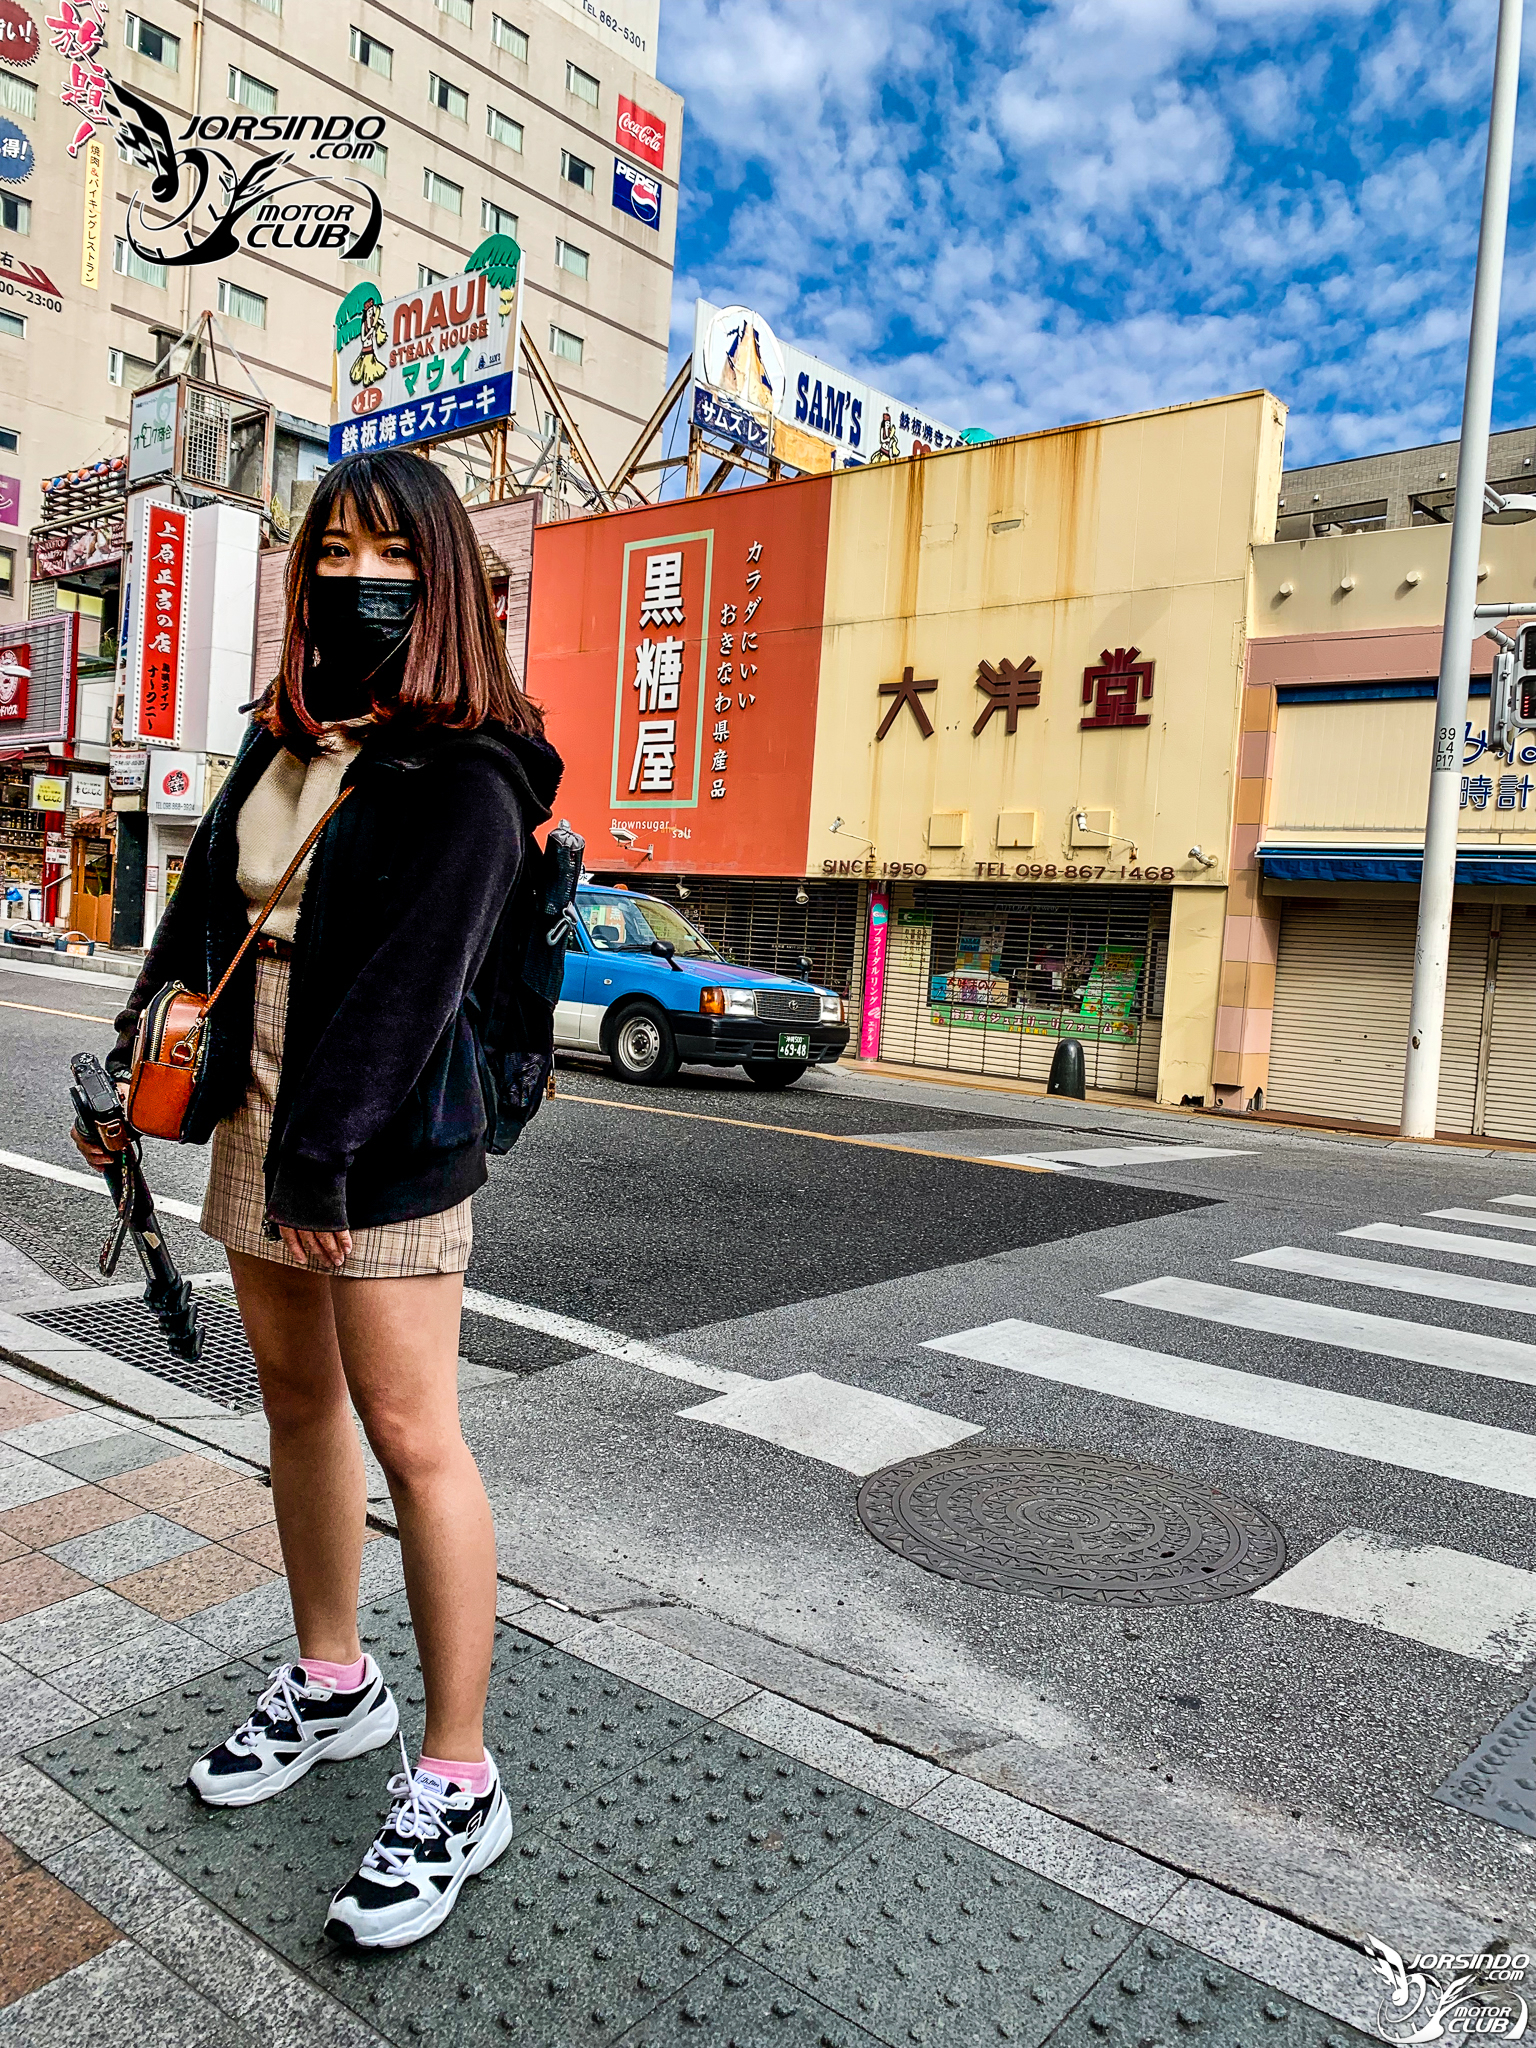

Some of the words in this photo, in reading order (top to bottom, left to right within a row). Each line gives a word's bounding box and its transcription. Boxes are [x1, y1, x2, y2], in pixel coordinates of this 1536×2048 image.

[582, 0, 598, 19] TEL
[599, 10, 647, 52] 862-5301
[615, 160, 659, 197] PEPSI
[392, 274, 488, 346] MAUI
[389, 336, 435, 368] STEAK
[439, 318, 488, 351] HOUSE
[402, 345, 471, 397] マウイ
[341, 384, 496, 455] 鉄板焼きステーキ
[362, 390, 377, 411] 1F
[796, 371, 863, 447] SAM'S
[149, 520, 180, 654] 上原正吉の店
[738, 540, 764, 710] カラダにいい
[628, 550, 687, 792] 黒糖屋
[875, 646, 1156, 742] 大洋堂
[710, 602, 738, 800] おきなわ県産品
[1439, 727, 1456, 741] 39
[1435, 754, 1454, 767] P17
[155, 801, 163, 811] TEL
[1460, 774, 1535, 809] 時計
[611, 818, 670, 832] Brownsugar
[672, 827, 692, 840] salt
[822, 859, 876, 876] SINCE
[882, 861, 928, 877] 1950
[975, 861, 1011, 878] TEL
[1015, 862, 1176, 882] 098-867-1468
[869, 926, 884, 1005] ブライダルリング
[784, 1044, 807, 1057] 69-48
